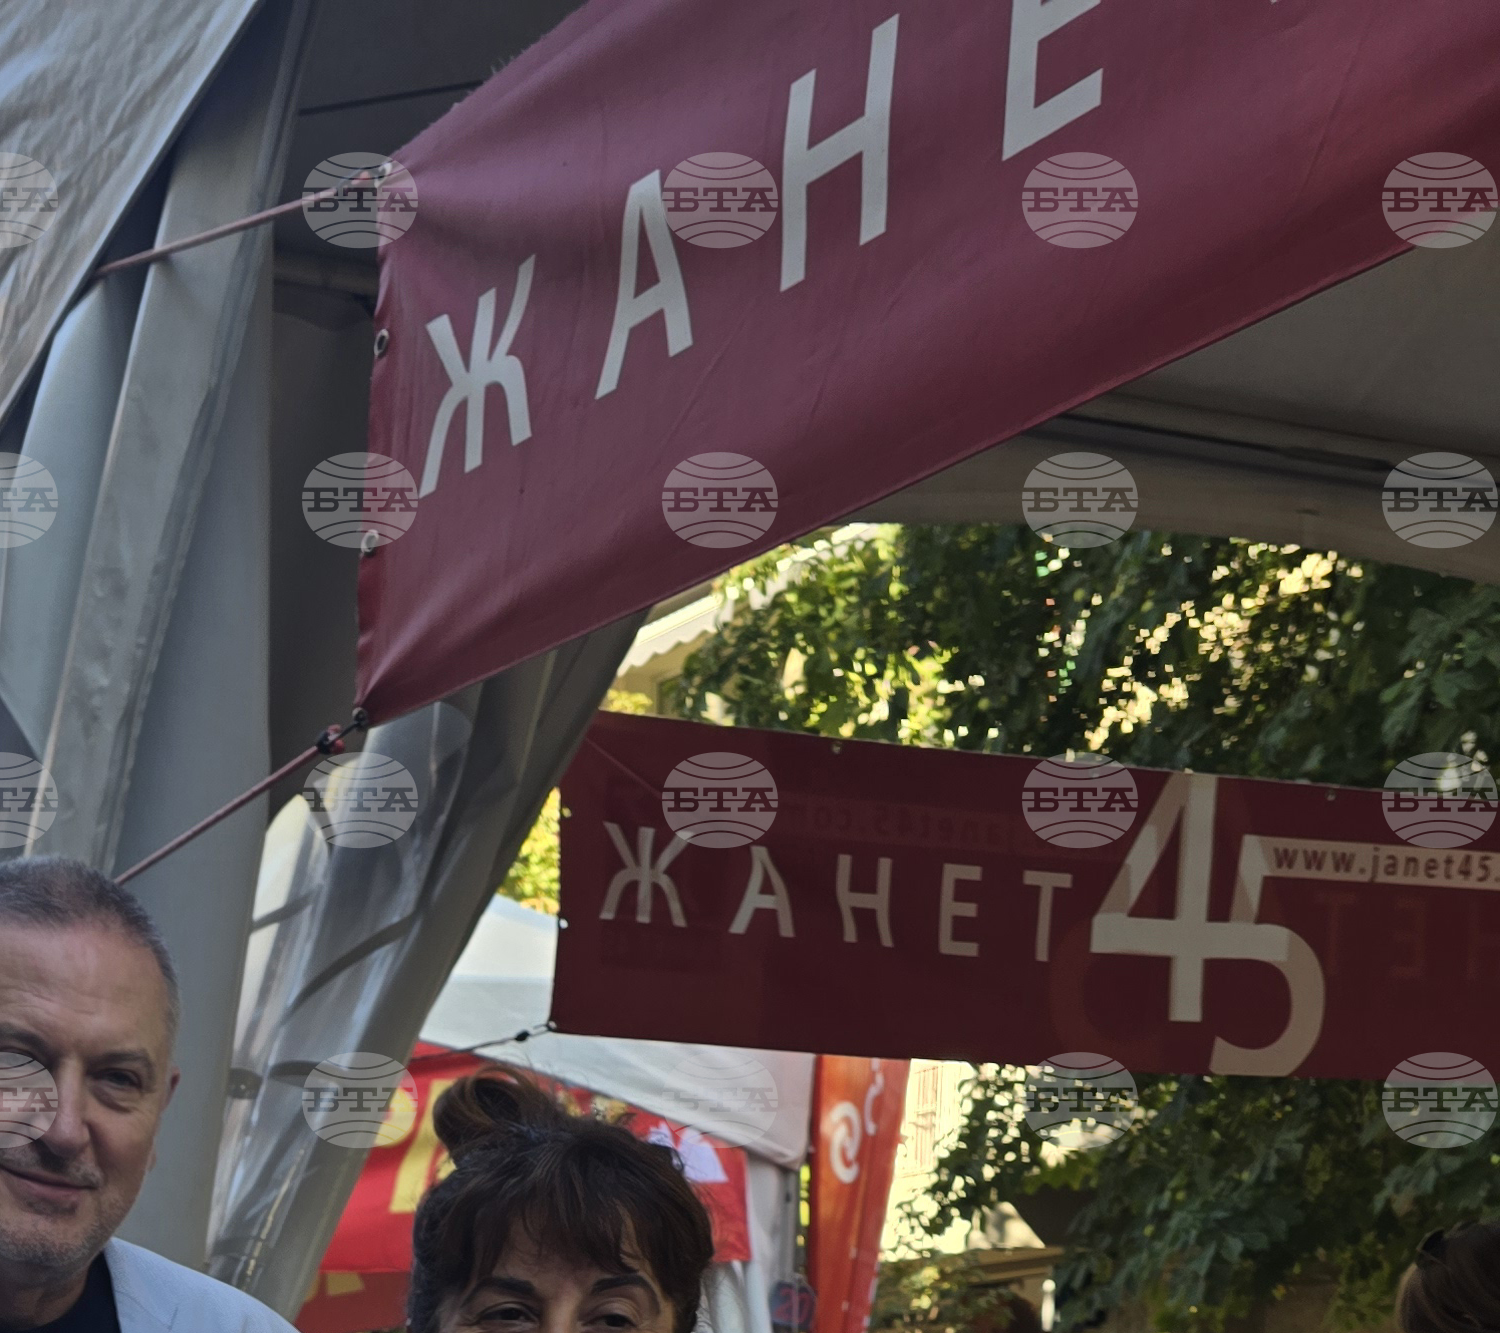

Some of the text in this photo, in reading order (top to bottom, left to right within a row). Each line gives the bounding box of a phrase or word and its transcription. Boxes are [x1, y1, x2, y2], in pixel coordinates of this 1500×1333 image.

[420, 0, 1104, 499] ЖАНЕ
[599, 819, 1074, 963] ЖАНЕТ
[1089, 772, 1327, 1077] 45
